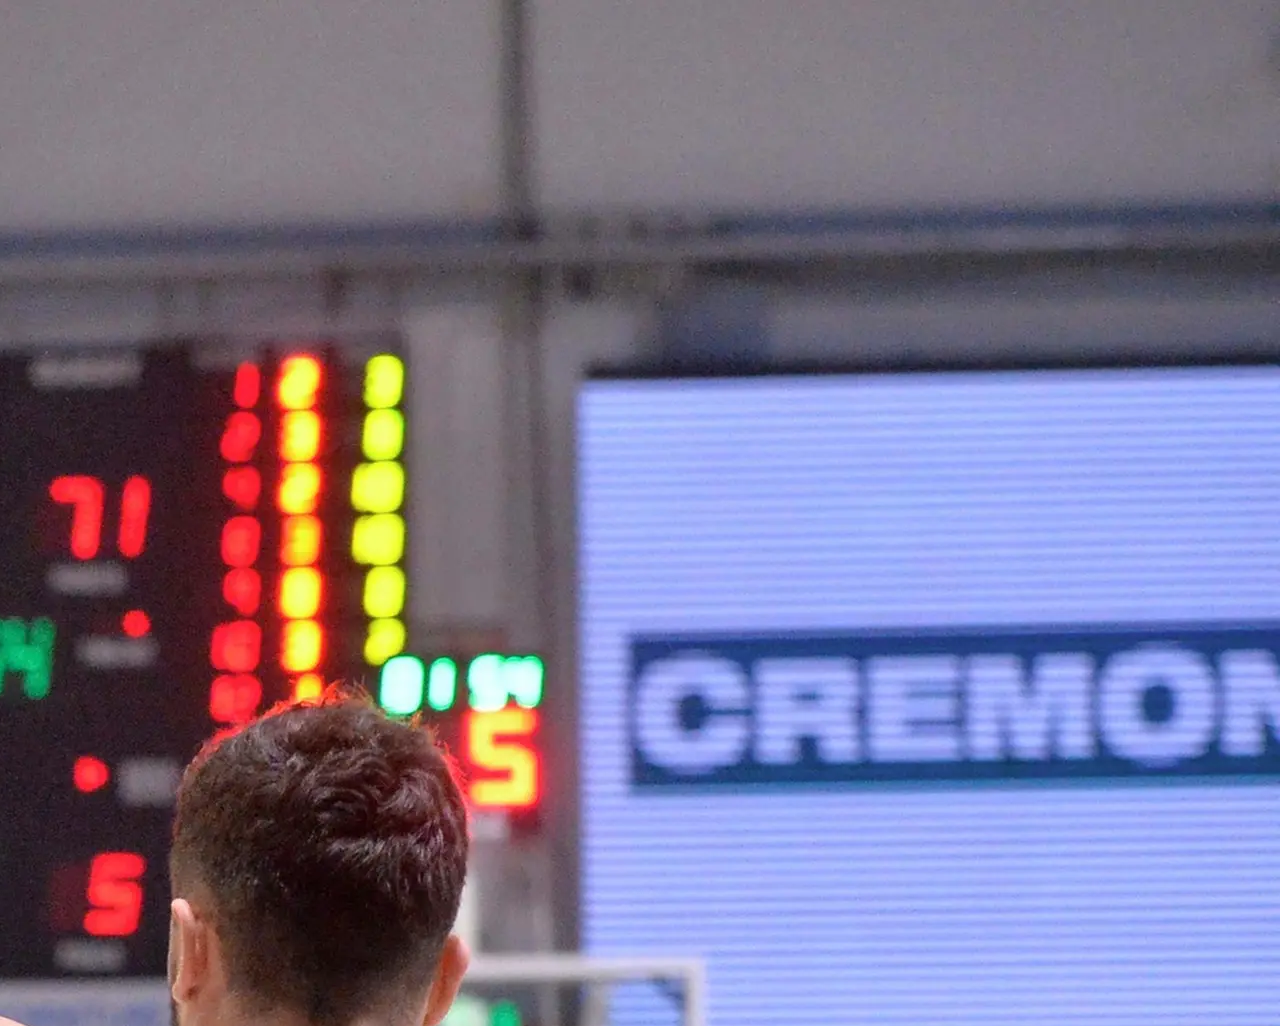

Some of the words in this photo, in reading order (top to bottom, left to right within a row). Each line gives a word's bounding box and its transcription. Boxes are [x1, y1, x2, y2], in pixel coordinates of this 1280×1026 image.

[48, 474, 152, 560] 71
[466, 707, 544, 810] 5
[82, 851, 146, 937] 5
